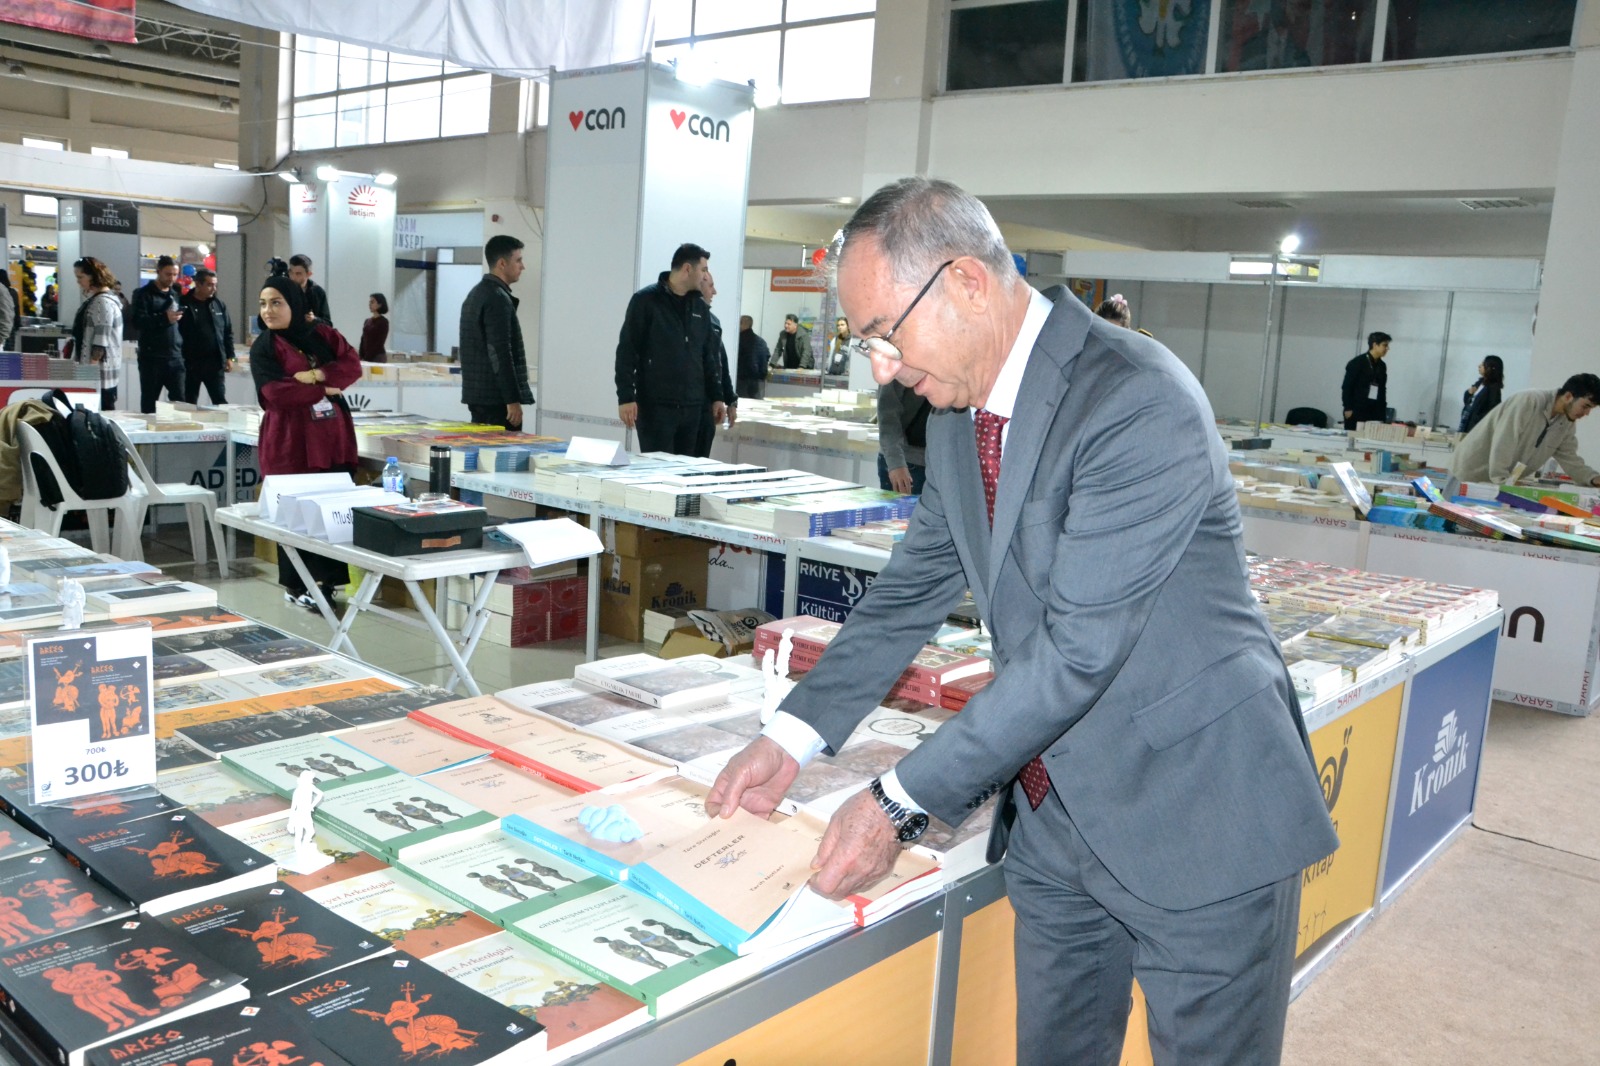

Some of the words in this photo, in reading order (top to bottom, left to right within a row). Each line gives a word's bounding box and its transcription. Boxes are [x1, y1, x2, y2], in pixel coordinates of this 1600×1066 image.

[585, 107, 625, 131] can
[688, 113, 730, 142] can
[91, 216, 130, 227] EPHESUS
[190, 467, 263, 489] ADED
[508, 487, 534, 501] SARAY
[1313, 515, 1347, 527] SARAY
[800, 562, 842, 584] RKİYE
[652, 591, 697, 609] Kronik
[801, 601, 842, 621] Kültür
[1337, 685, 1363, 710] SARAY
[1512, 693, 1554, 709] SARAY
[64, 759, 129, 786] 300₺
[1409, 731, 1469, 817] Kronik
[683, 844, 697, 853] Töre
[693, 834, 746, 869] DEFTERLER
[1302, 853, 1335, 888] Kitap
[343, 879, 396, 898] Arkeolojisi
[355, 887, 394, 902] Denemeler
[459, 945, 514, 969] Arkeolojisi
[473, 954, 514, 972] Denemeler
